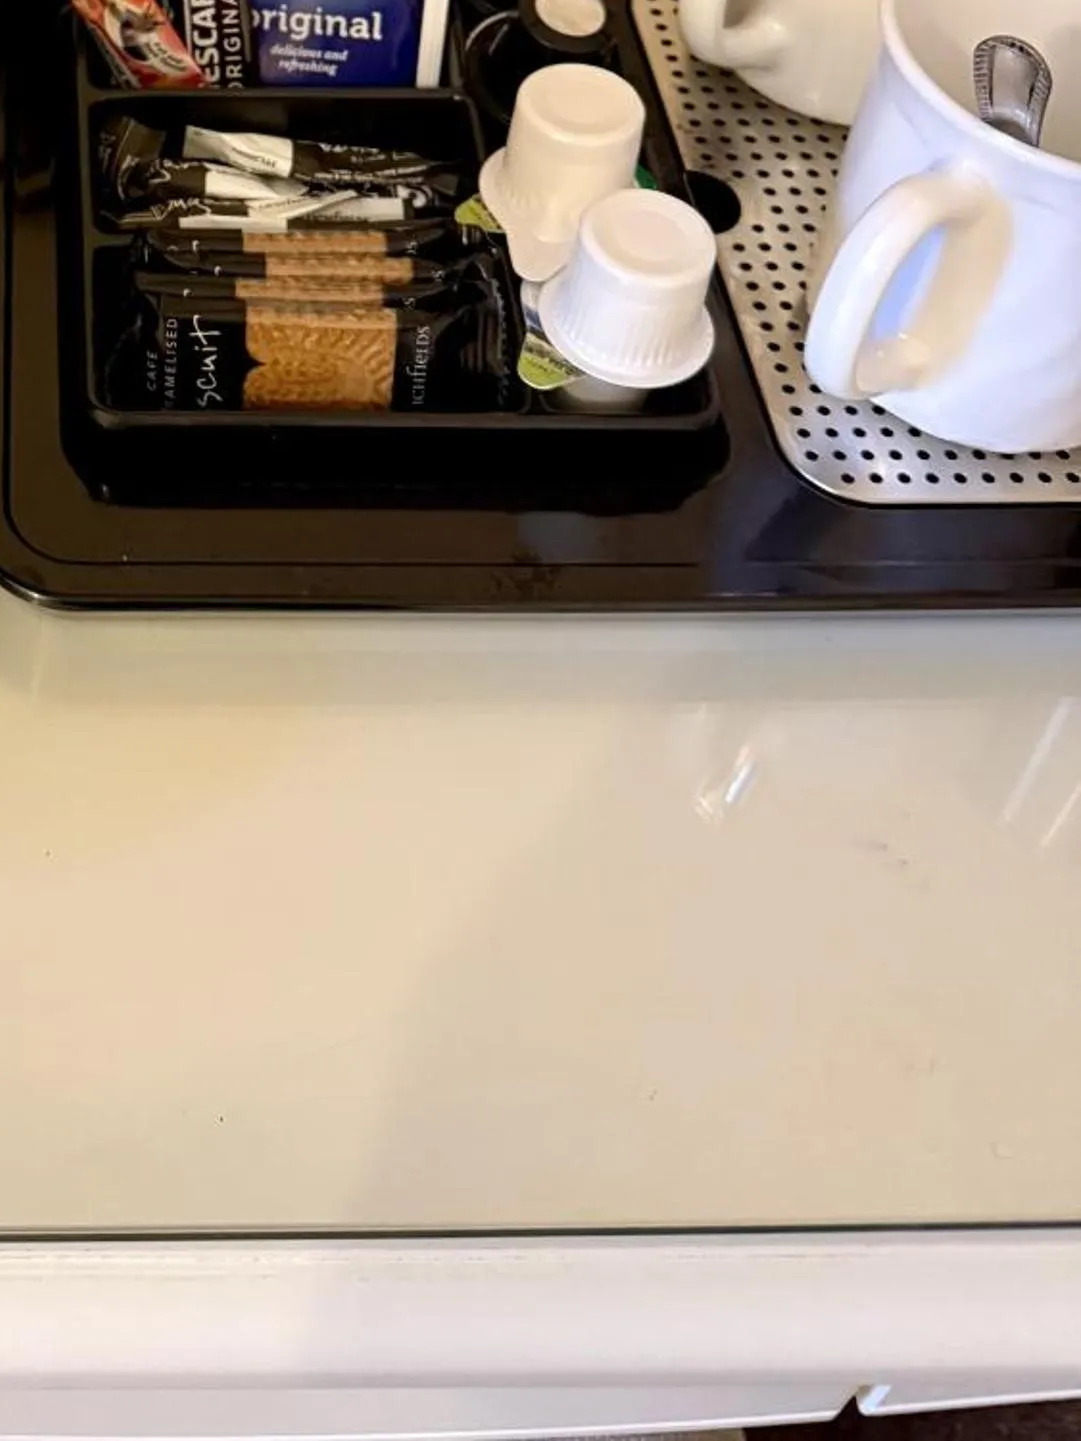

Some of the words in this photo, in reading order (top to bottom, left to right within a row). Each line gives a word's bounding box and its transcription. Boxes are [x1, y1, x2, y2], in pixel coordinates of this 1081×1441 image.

[271, 44, 322, 59] delicious
[324, 50, 349, 61] and
[279, 59, 338, 76] refreshing
[189, 314, 223, 407] scuit
